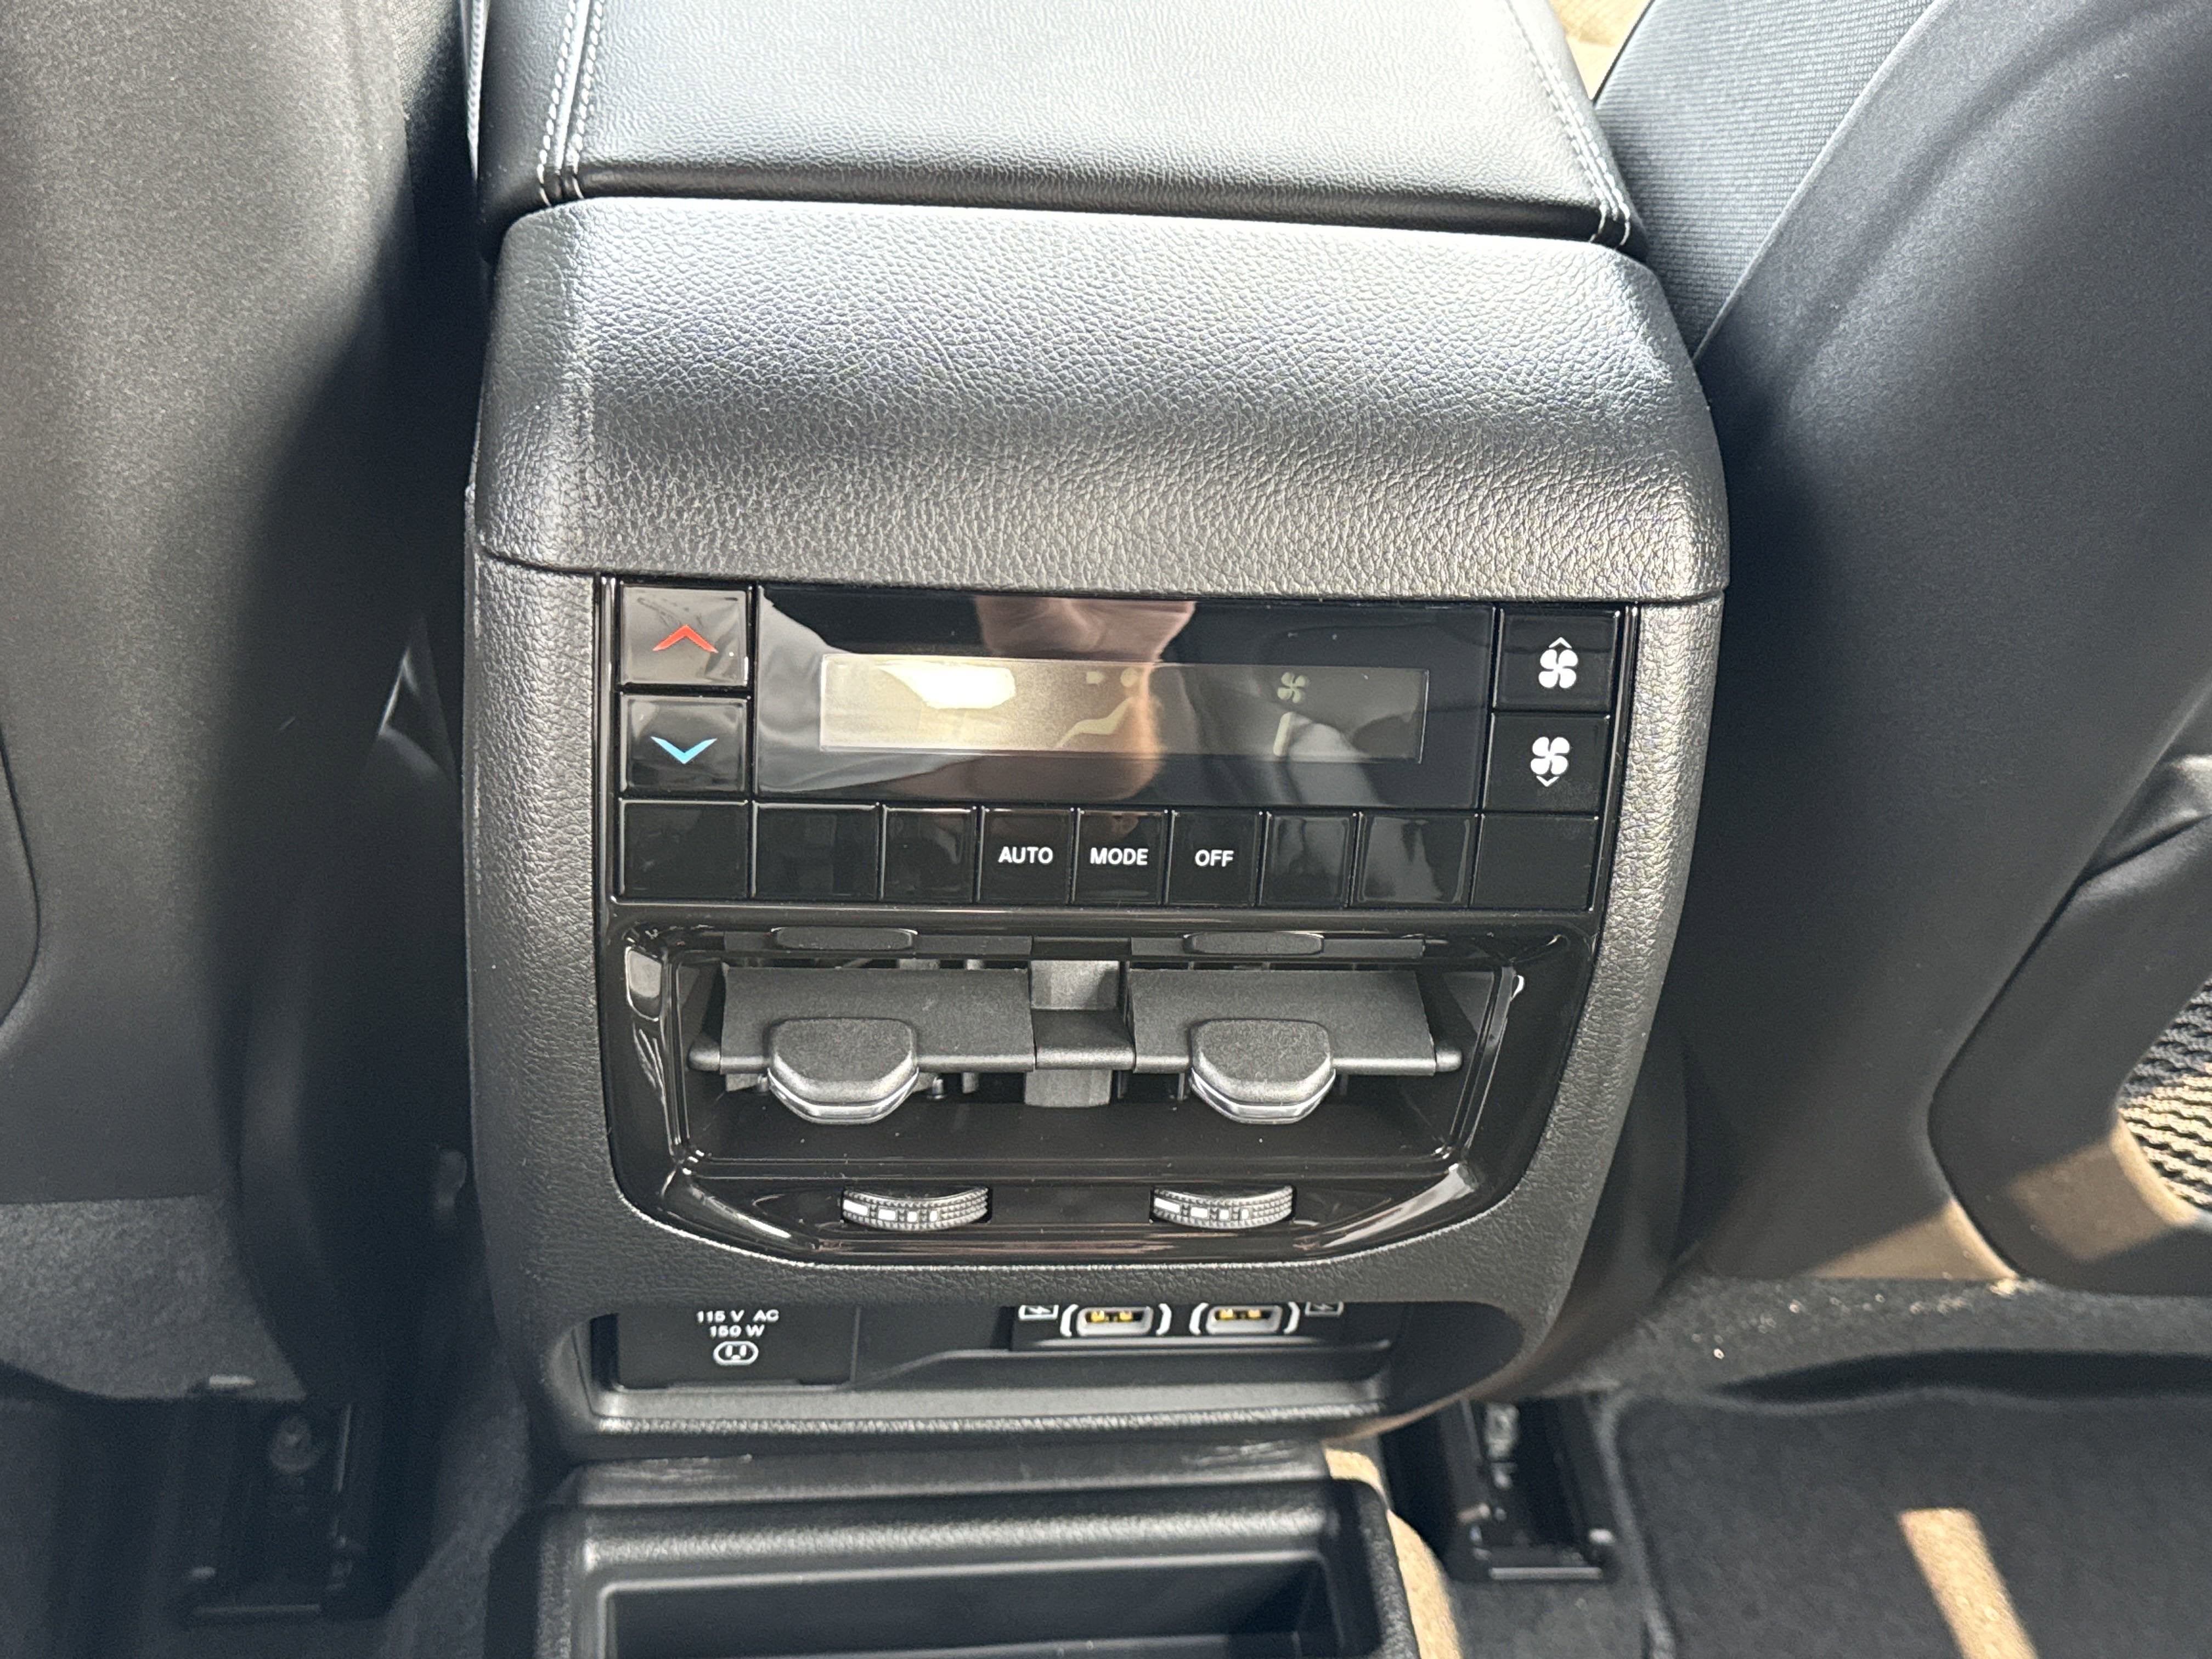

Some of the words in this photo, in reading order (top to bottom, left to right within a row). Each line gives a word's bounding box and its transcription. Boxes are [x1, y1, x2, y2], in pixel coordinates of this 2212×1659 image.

[997, 846, 1053, 865] AUTO
[1090, 847, 1149, 866] MODE
[1194, 849, 1234, 867] OFF
[696, 1310, 726, 1323] 115
[730, 1310, 745, 1323] V
[752, 1309, 780, 1323] AC
[709, 1325, 742, 1338] 150
[745, 1324, 765, 1338] W
